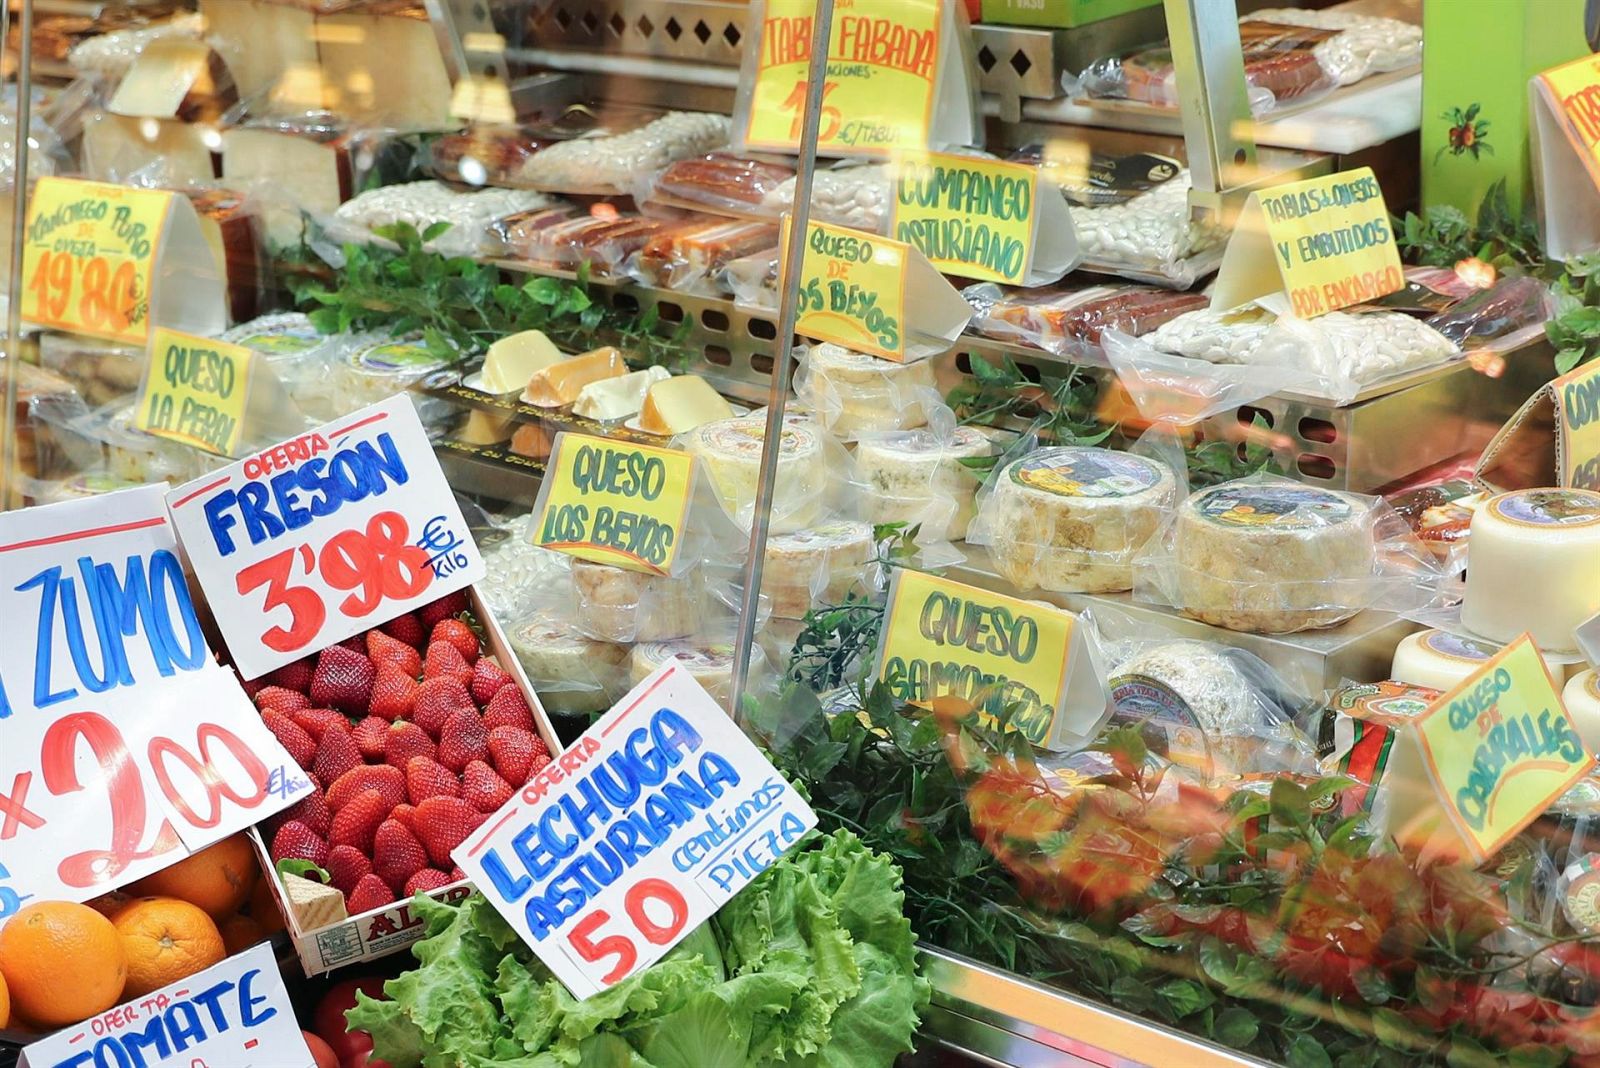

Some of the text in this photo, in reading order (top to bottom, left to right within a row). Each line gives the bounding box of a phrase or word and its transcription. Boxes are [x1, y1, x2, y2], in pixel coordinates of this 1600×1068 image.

[838, 15, 938, 78] FABADA
[899, 159, 1031, 223] COMPANGO
[1262, 188, 1322, 224] TABLAS
[111, 205, 151, 260] PURO
[810, 227, 873, 265] QUESO
[897, 218, 1025, 280] ASTURIANO
[1277, 218, 1390, 270] Y EMBUTIDOS
[28, 249, 137, 333] 19'80
[826, 259, 854, 281] DE
[1290, 264, 1401, 317] POR ENCARGO
[827, 279, 899, 351] BEYOS
[164, 344, 236, 400] QUESO
[146, 391, 174, 432] LA
[243, 433, 330, 481] OFERTA
[572, 444, 666, 502] QUESO
[203, 431, 410, 557] FRESÓN
[541, 503, 590, 545] LOS
[235, 510, 435, 653] 3'98
[13, 548, 208, 710] ZUMO
[918, 590, 1039, 664] QUESO
[1447, 667, 1512, 732] QUESO
[1475, 703, 1504, 738] DE
[521, 735, 602, 806] OFERTA
[479, 706, 704, 904] LECHUGA
[524, 750, 741, 943] ASTURIANA
[707, 810, 807, 894] PIEZA
[565, 877, 689, 987] 50
